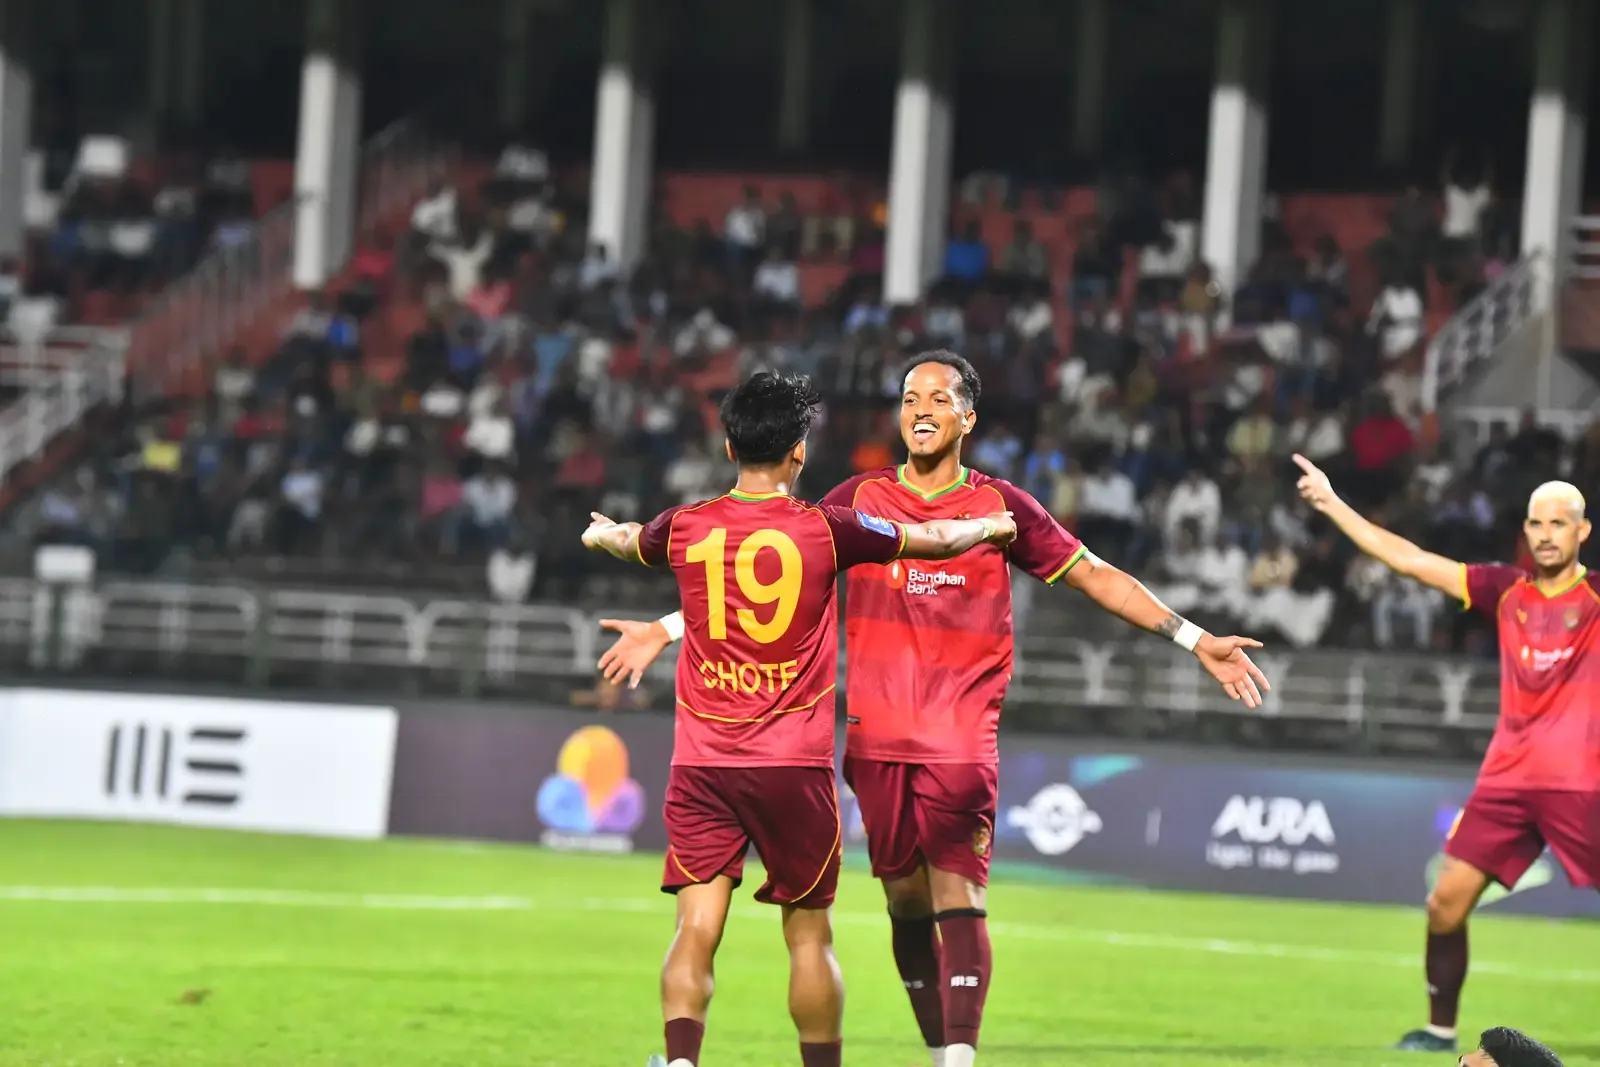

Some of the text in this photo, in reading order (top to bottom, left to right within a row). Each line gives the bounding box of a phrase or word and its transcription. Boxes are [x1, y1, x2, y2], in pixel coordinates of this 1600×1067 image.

[685, 527, 804, 644] 19
[906, 580, 938, 596] Bank
[907, 568, 966, 586] Bandhan
[699, 659, 799, 695] CHOTE
[1210, 793, 1337, 847] AURA
